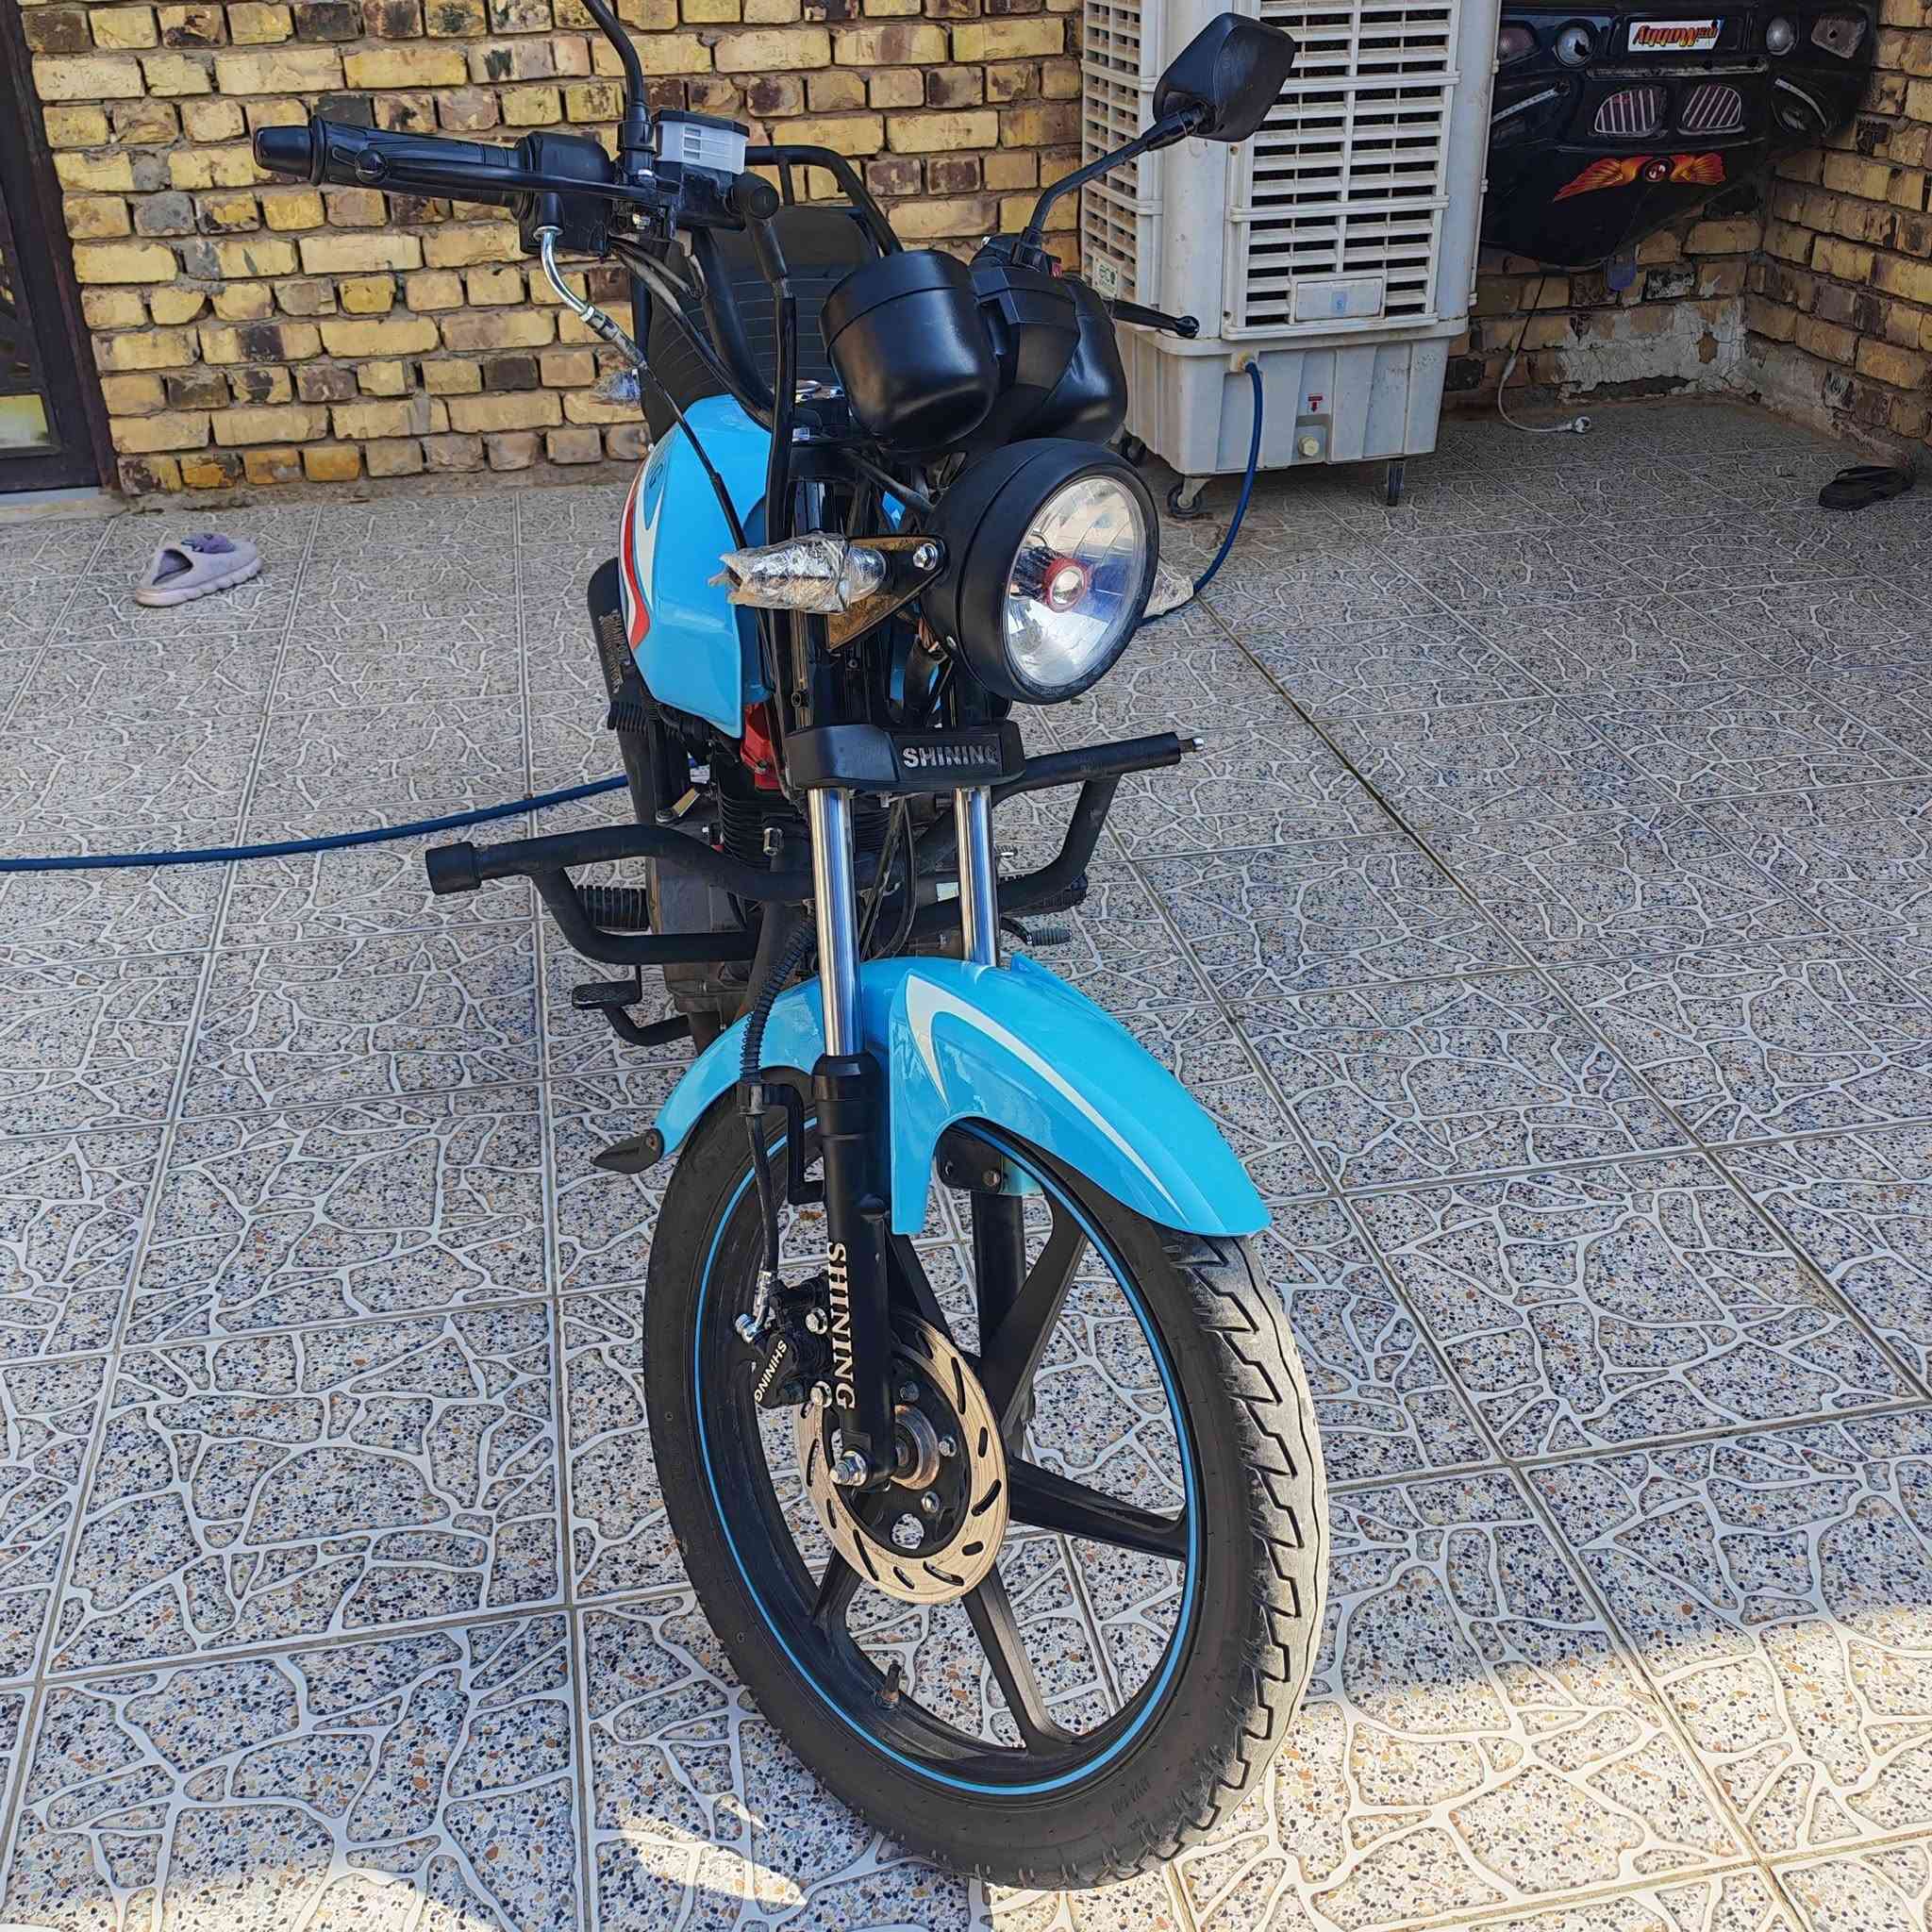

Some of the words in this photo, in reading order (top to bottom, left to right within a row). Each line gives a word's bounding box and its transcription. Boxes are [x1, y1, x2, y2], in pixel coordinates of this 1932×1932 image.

[903, 745, 998, 768] SHINING
[827, 1241, 856, 1410] SHINING
[754, 1340, 788, 1403] SHINING
